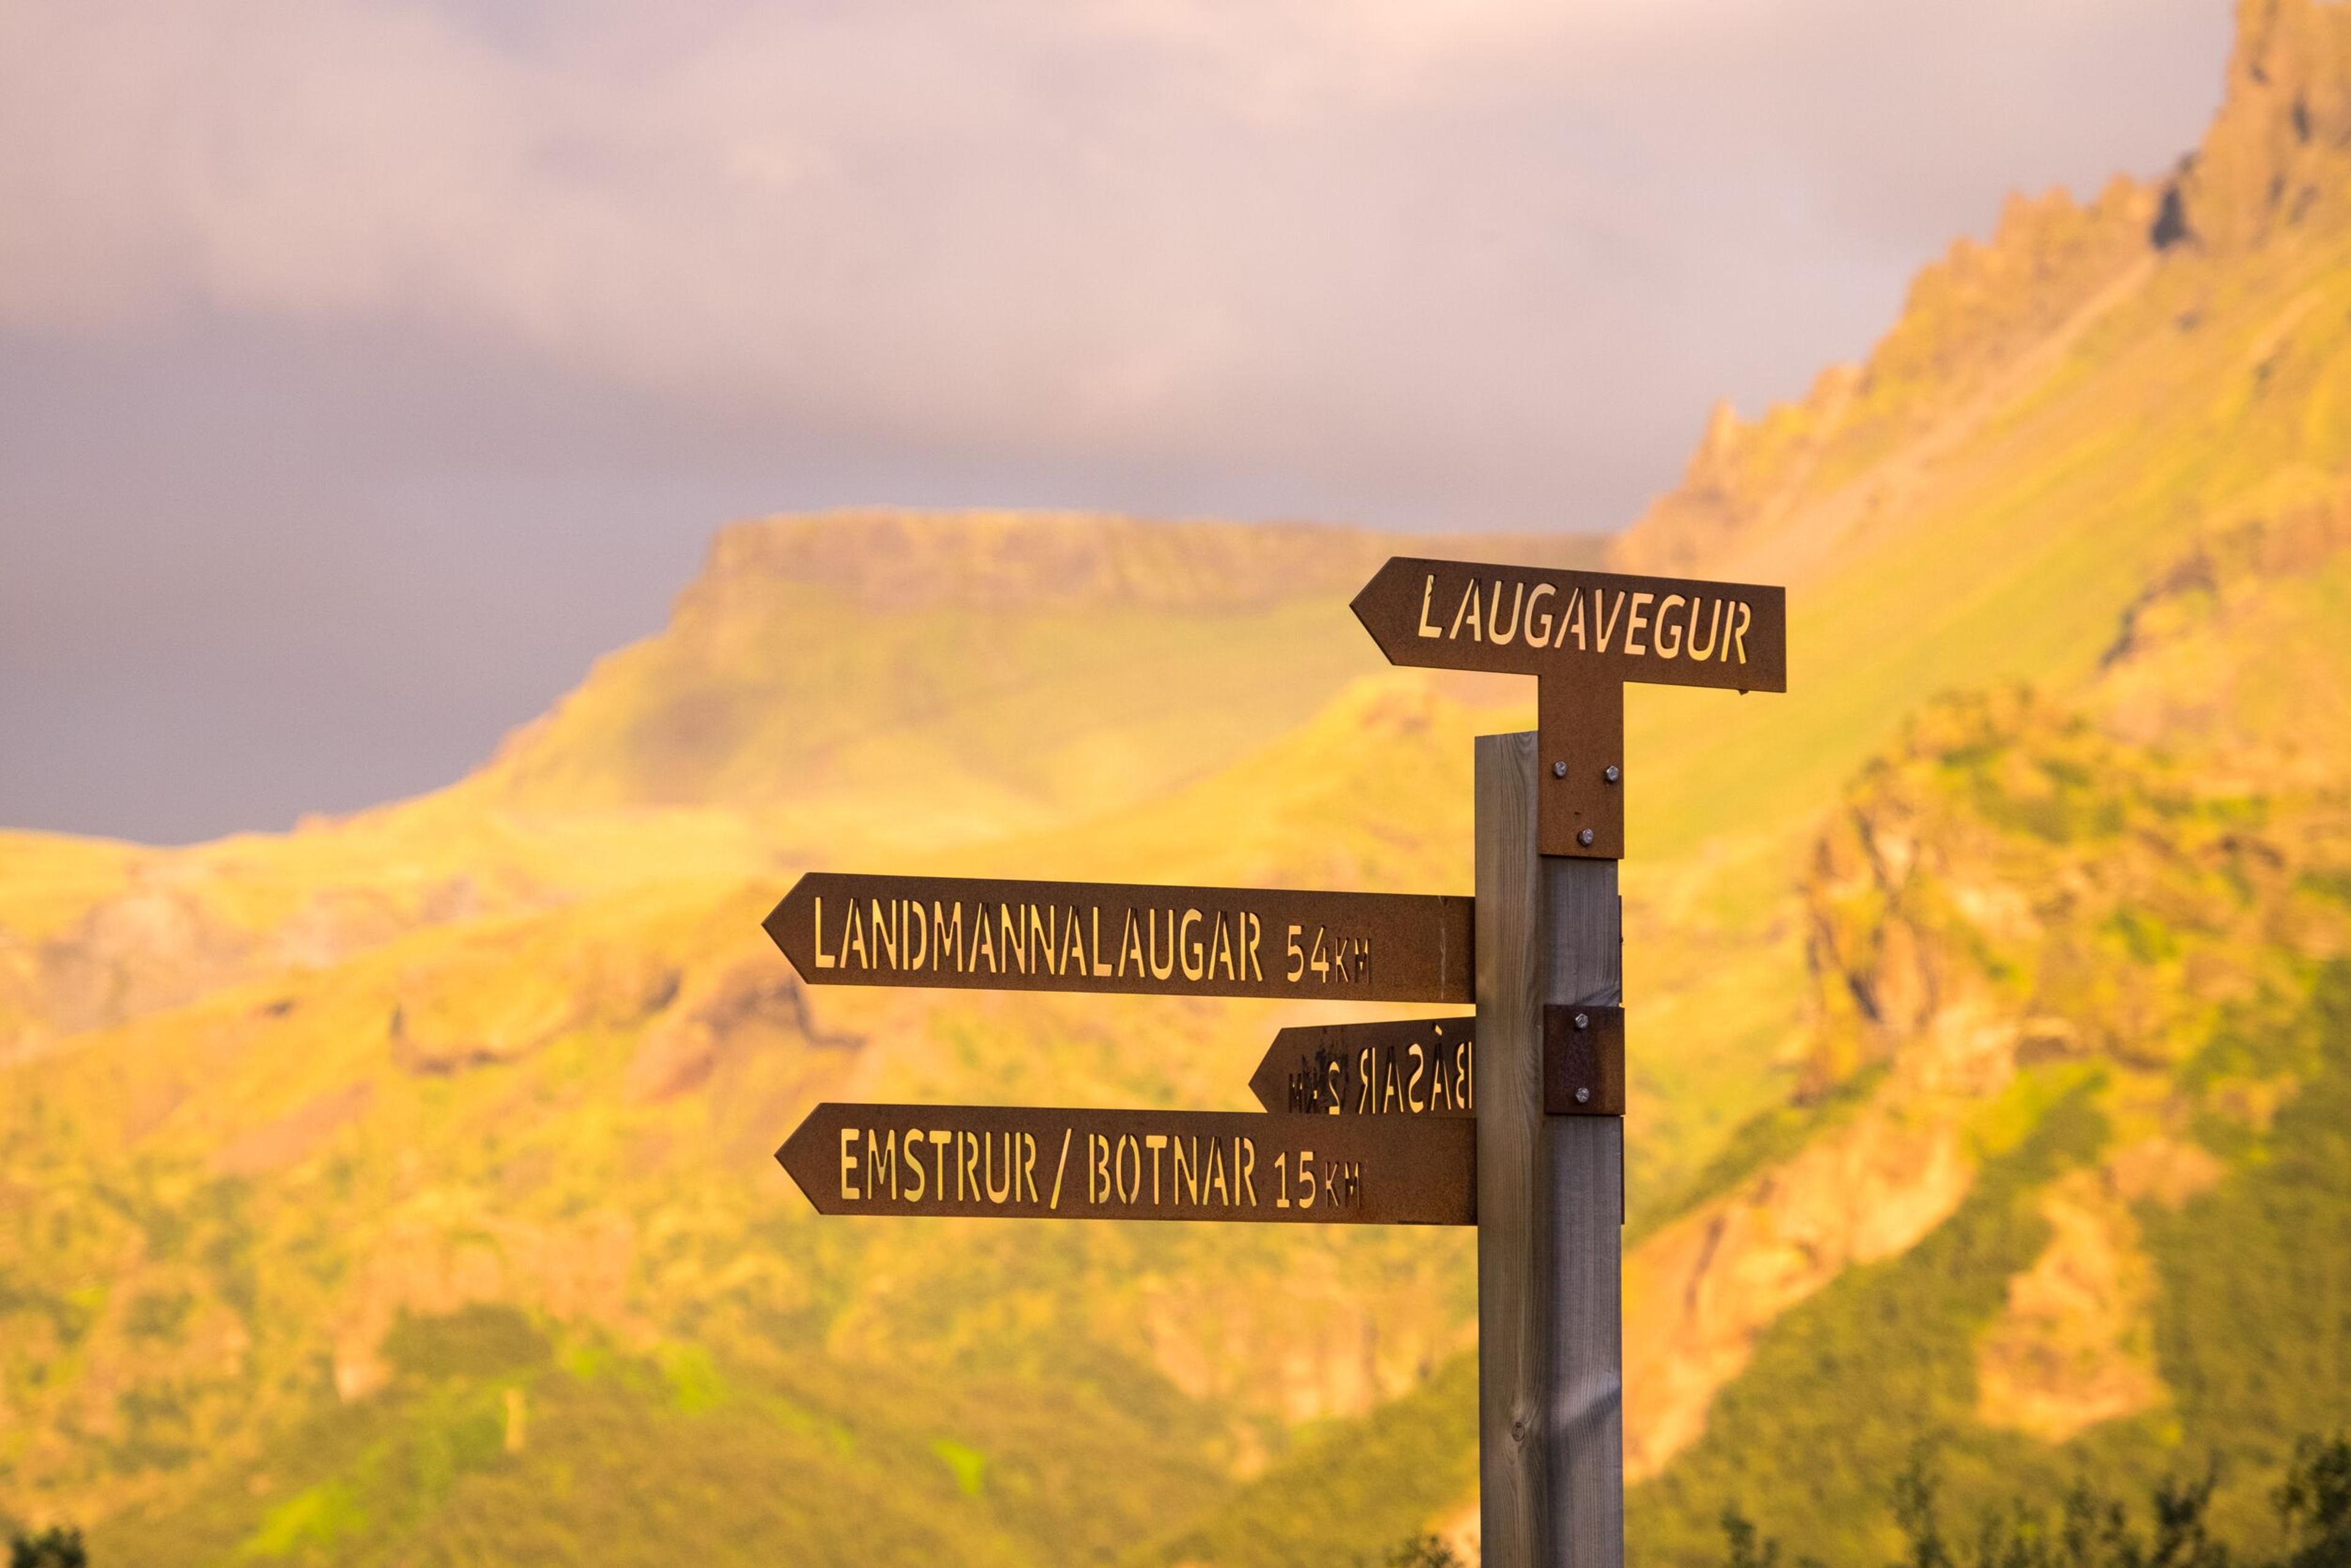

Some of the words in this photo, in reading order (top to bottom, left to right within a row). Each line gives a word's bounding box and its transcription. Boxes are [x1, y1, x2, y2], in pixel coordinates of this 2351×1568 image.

[1418, 574, 1751, 664] LAUGAVEGUR
[815, 896, 1263, 982] LANDMANNALAUGAR
[841, 1128, 1039, 1204] EMSTRUR
[1089, 1133, 1257, 1207] BOTNAR
